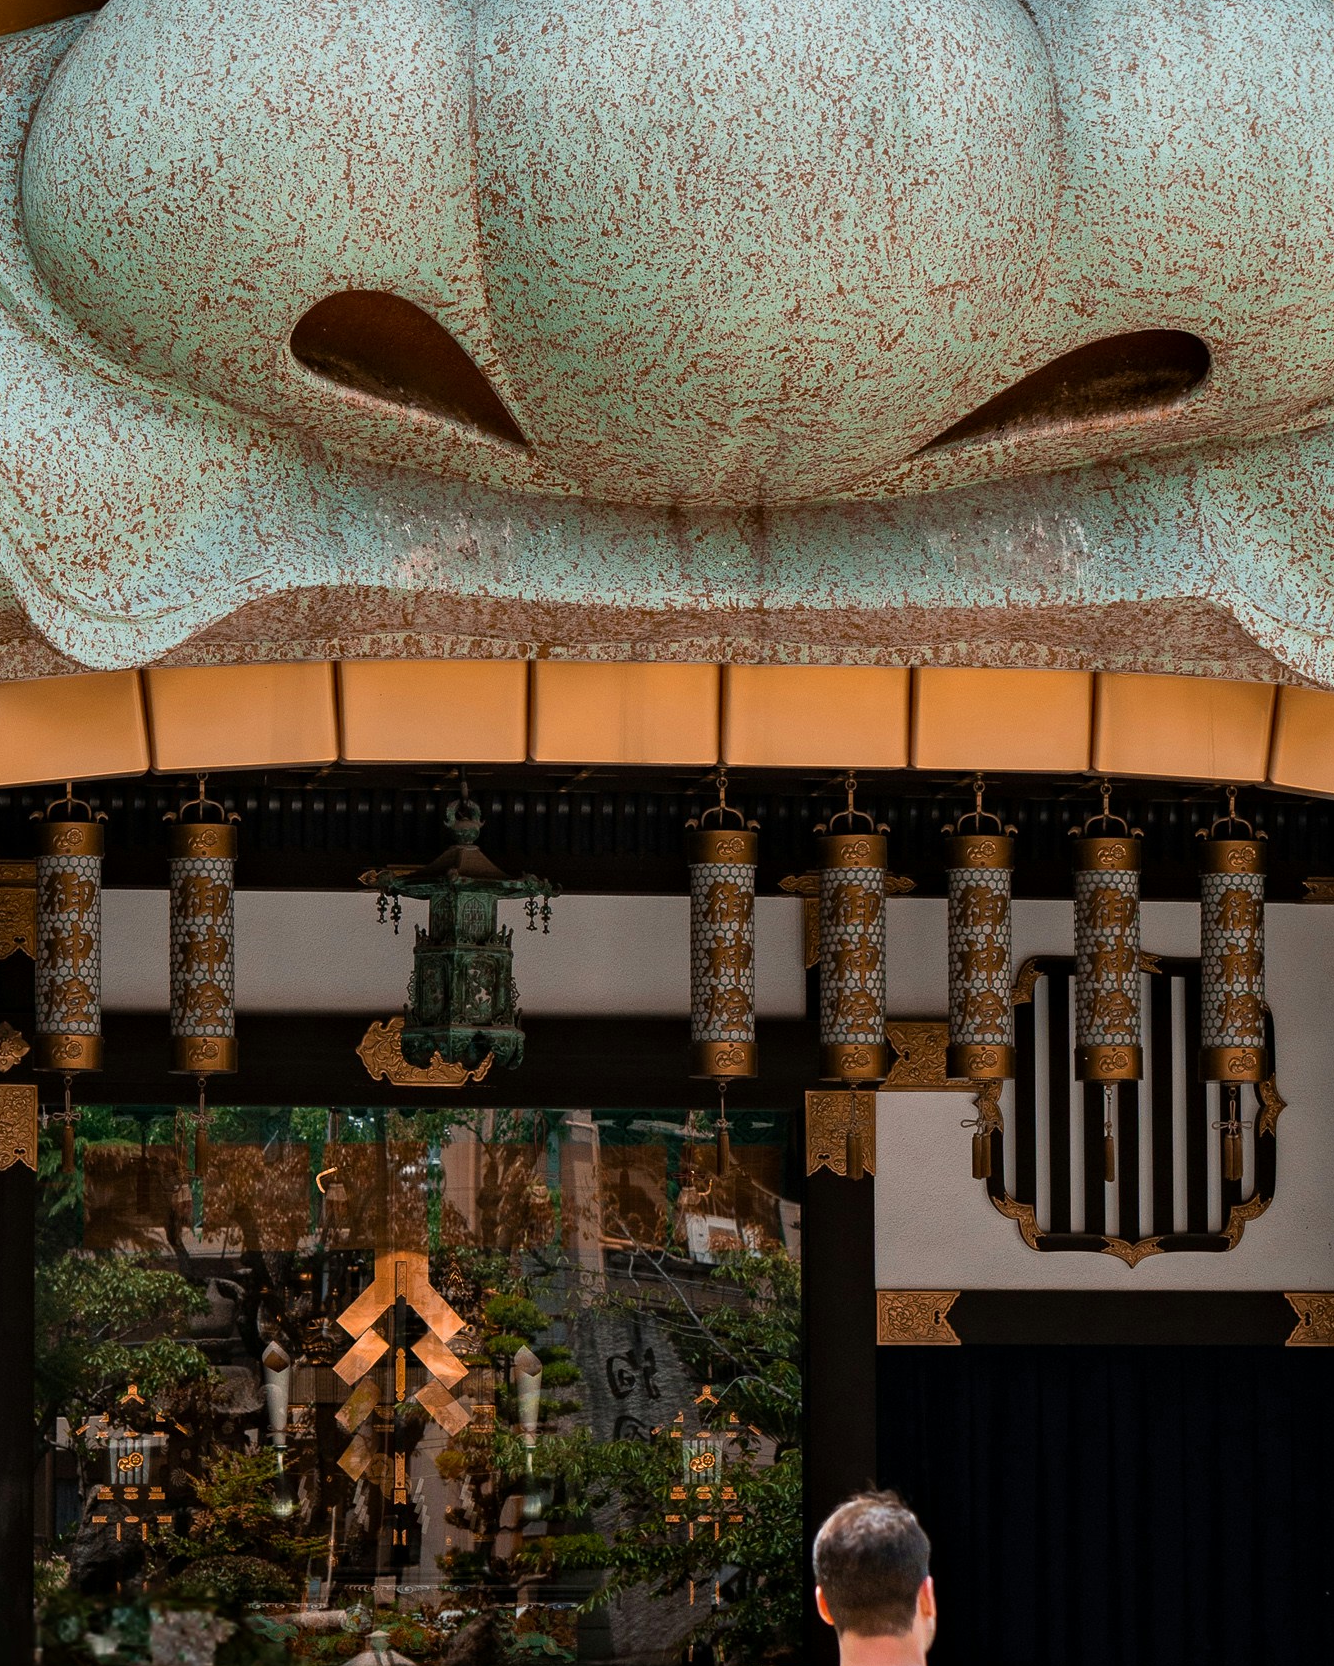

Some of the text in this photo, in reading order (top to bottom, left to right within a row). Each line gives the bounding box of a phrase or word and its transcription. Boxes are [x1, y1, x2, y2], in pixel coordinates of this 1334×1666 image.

[39, 871, 95, 1024] 御神燈
[178, 874, 230, 1027] 御神燈
[703, 880, 755, 1032] 御神燈
[828, 884, 881, 1032] 御神燈
[956, 885, 1008, 1032] 御神燈
[1085, 887, 1137, 1033] 御神燈
[1216, 888, 1264, 1037] 御神燈
